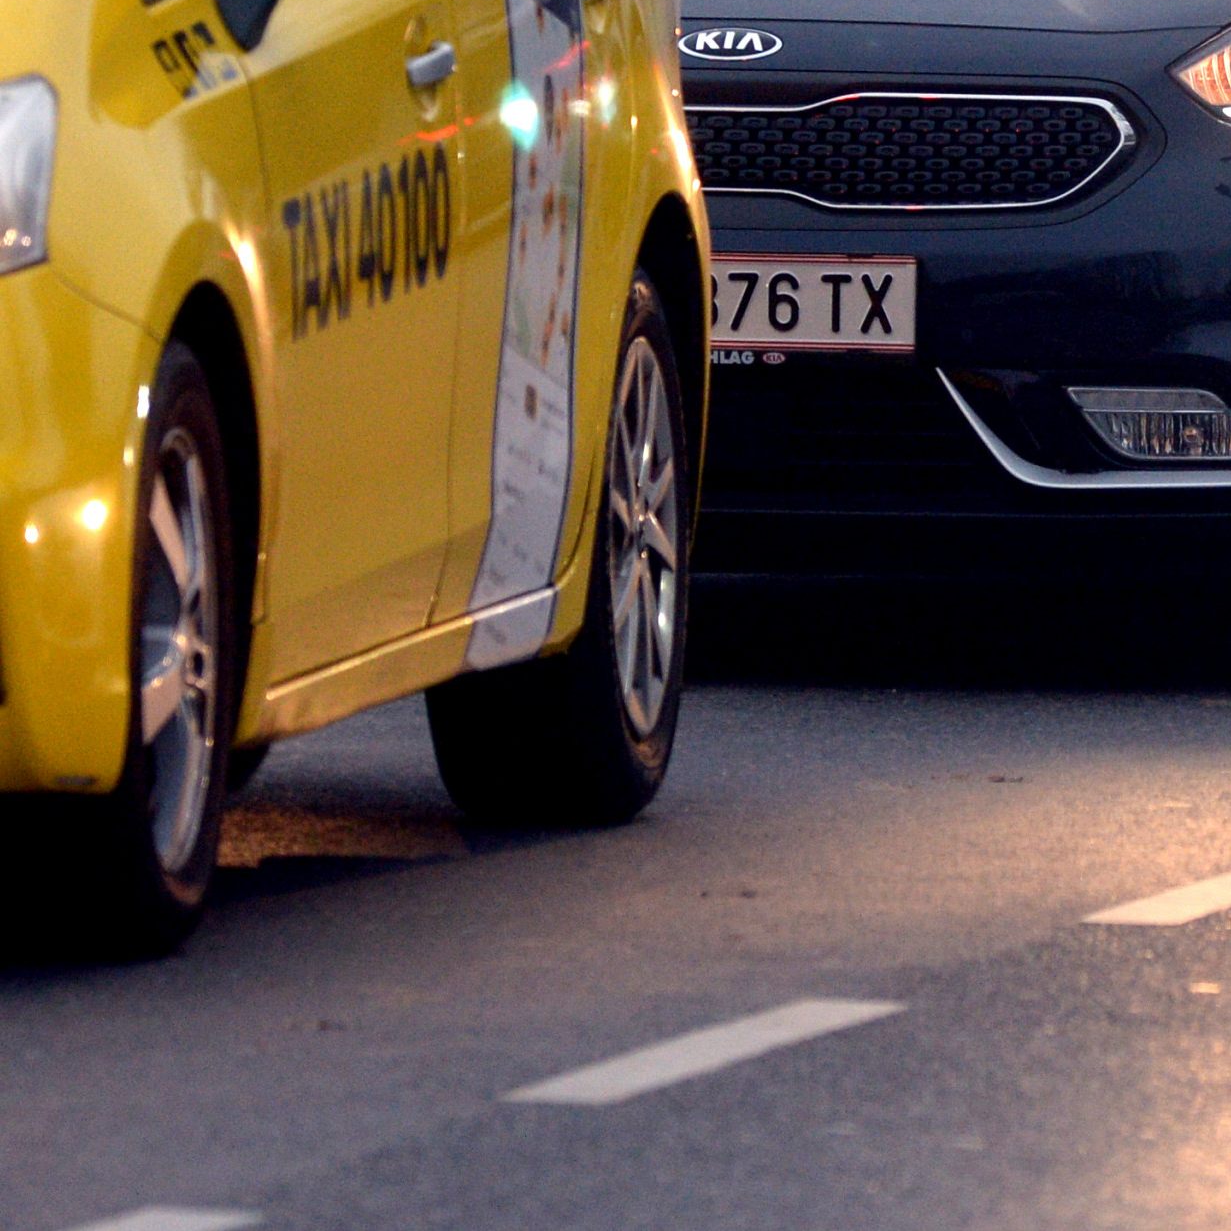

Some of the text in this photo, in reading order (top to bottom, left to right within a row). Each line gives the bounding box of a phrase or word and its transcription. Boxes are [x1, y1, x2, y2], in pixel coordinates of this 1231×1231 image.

[696, 31, 764, 51] KIA
[283, 180, 350, 343] TAXI
[821, 273, 893, 334] TX
